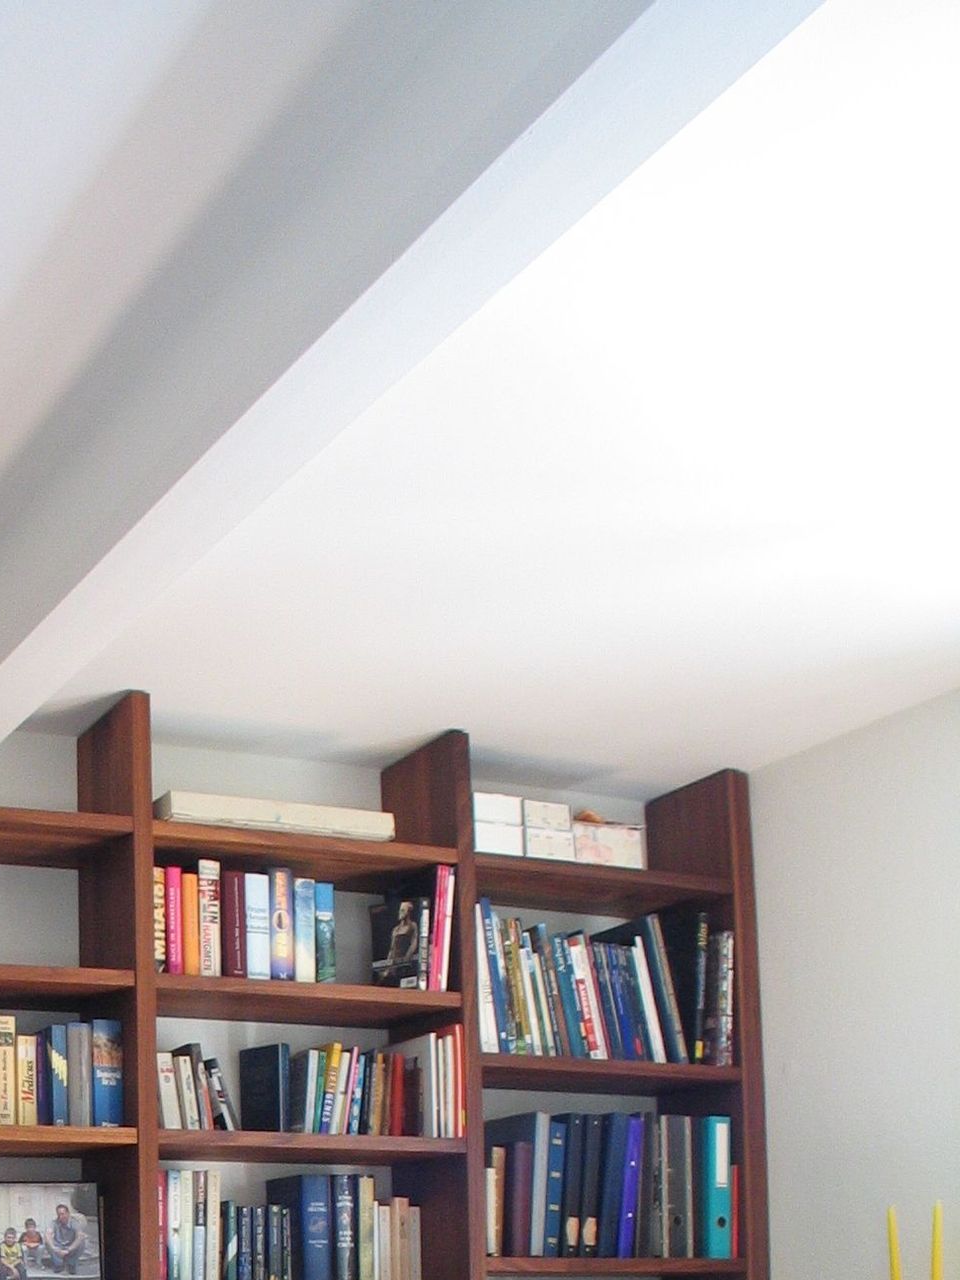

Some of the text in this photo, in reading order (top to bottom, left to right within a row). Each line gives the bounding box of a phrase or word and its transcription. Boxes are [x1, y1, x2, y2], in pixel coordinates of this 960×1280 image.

[206, 879, 219, 925] STALIN
[202, 925, 213, 971] HANGMEN
[698, 922, 708, 949] Atlas
[21, 1060, 35, 1105] Medicus
